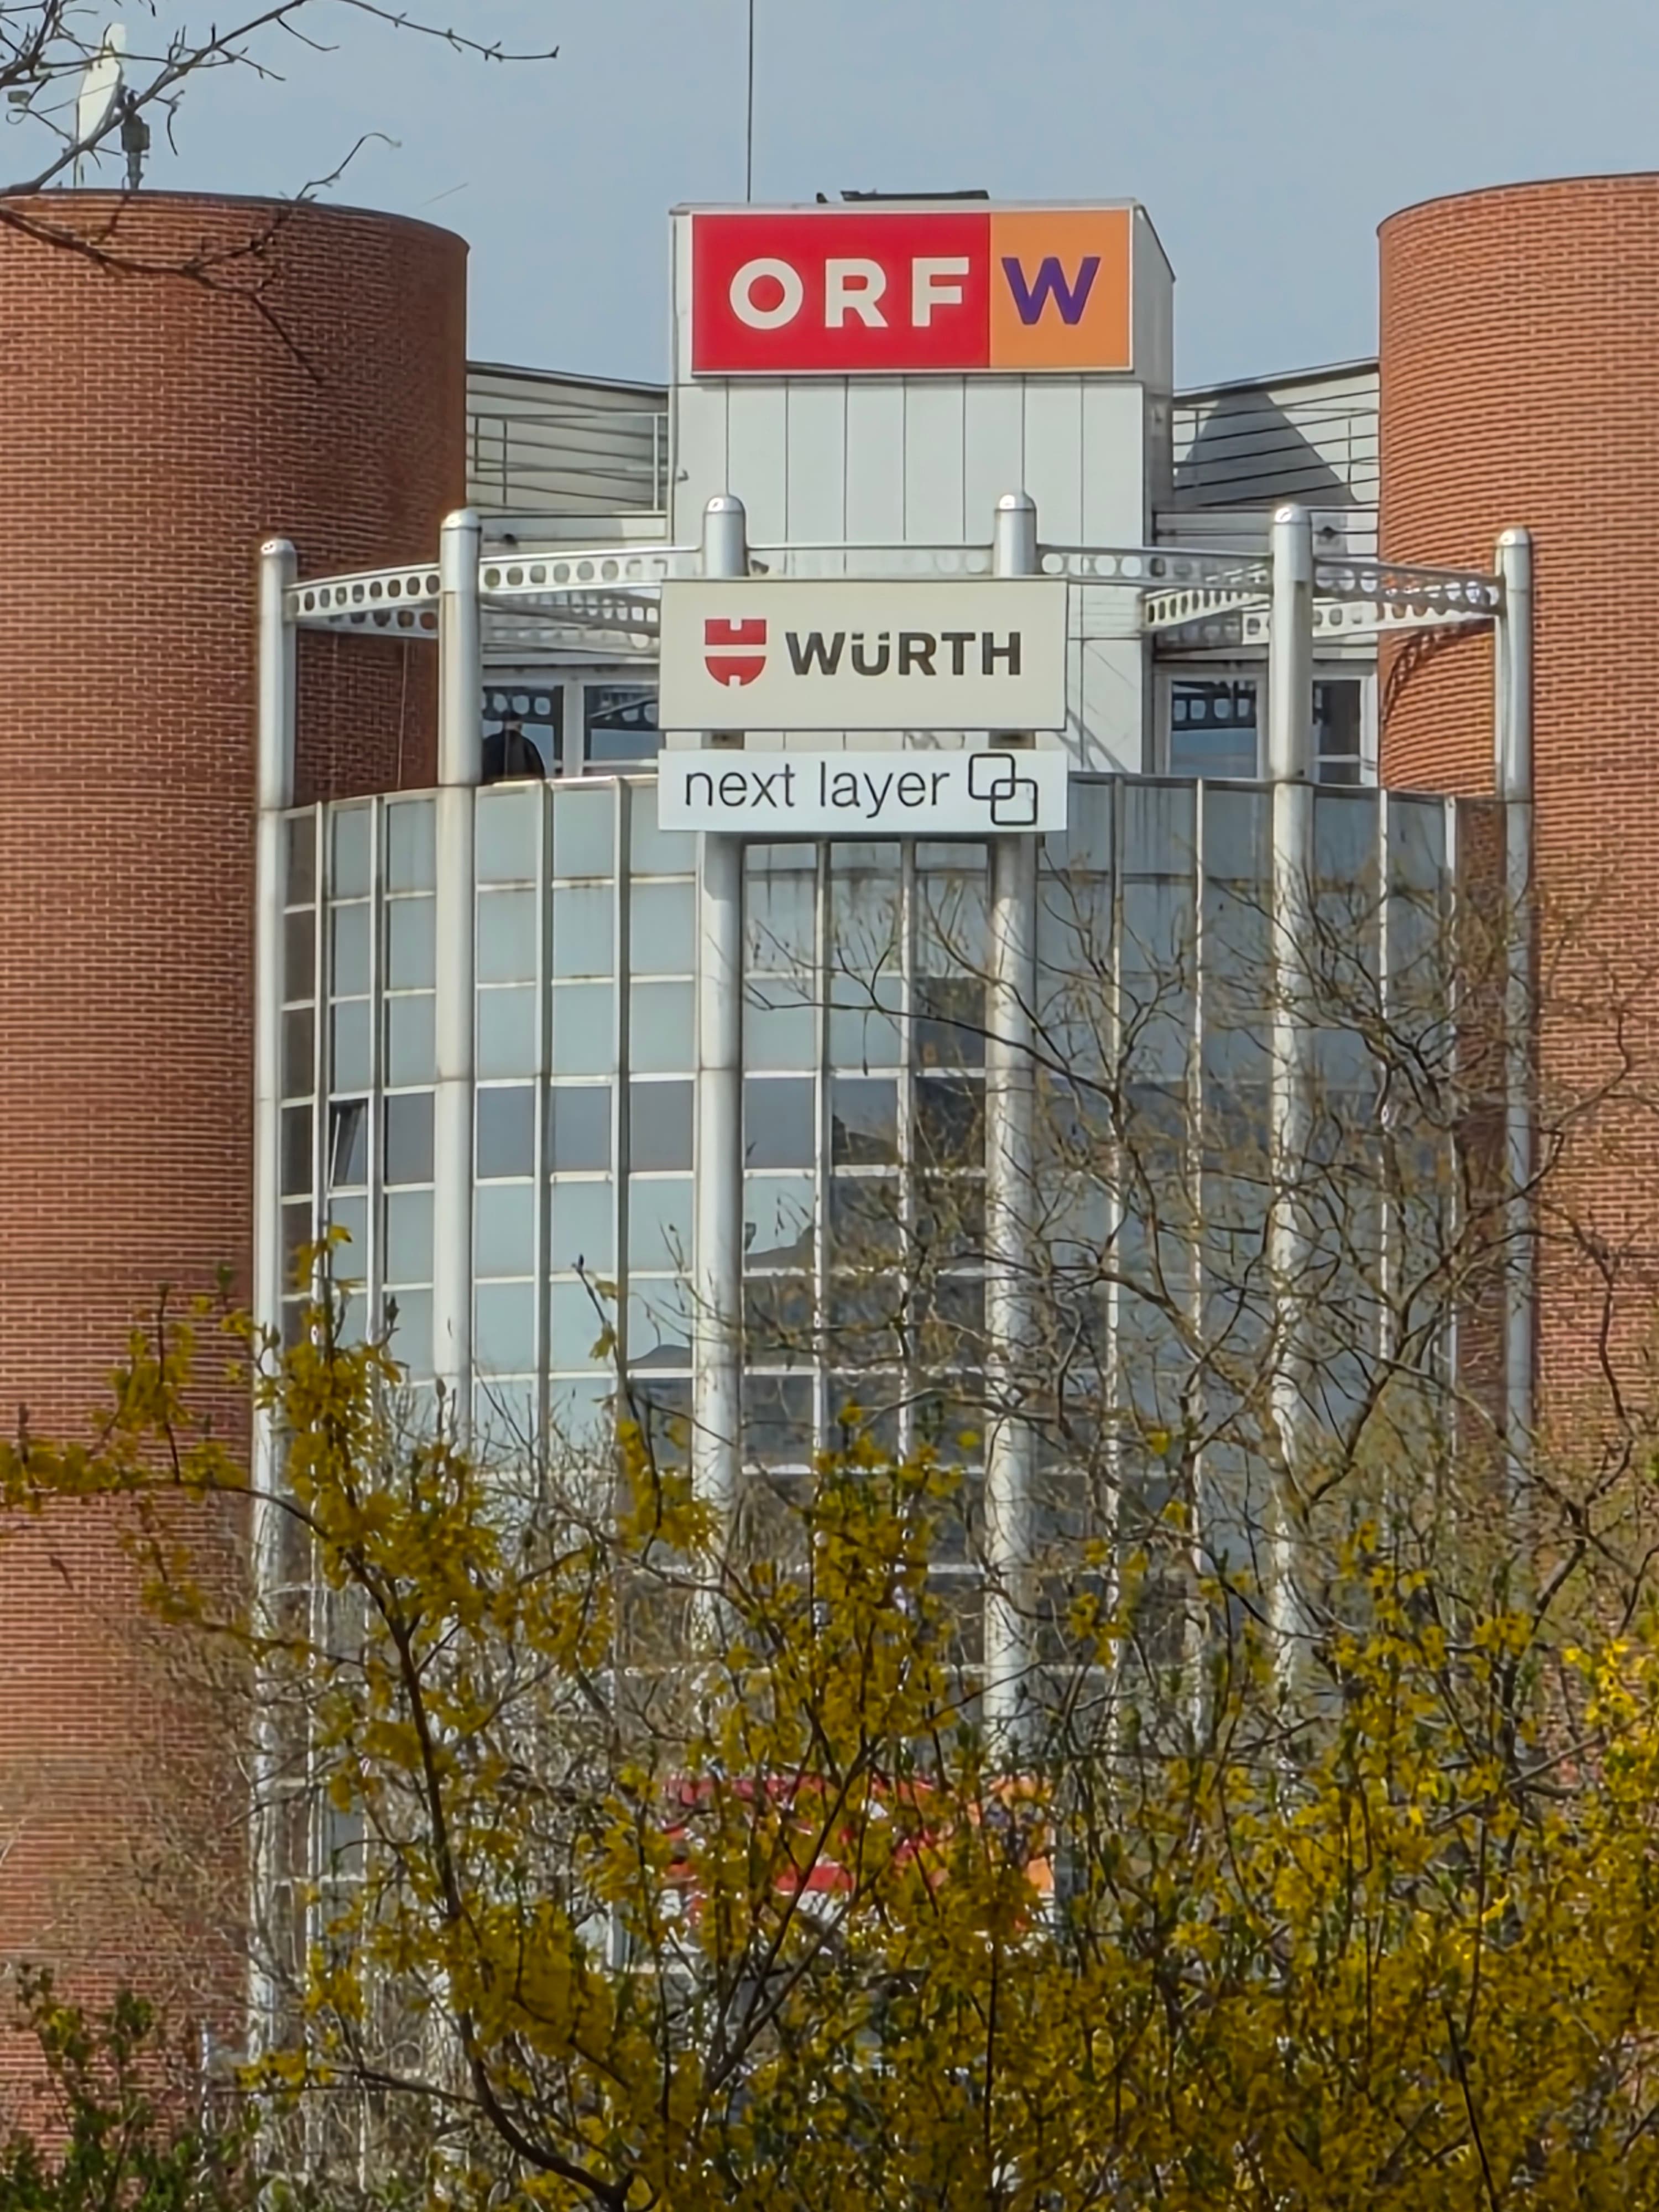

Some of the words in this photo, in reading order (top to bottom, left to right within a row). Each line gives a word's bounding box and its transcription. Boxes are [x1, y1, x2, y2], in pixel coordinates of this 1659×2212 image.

[784, 631, 1021, 676] WÜRTH
[685, 763, 796, 808] next
[820, 760, 951, 819] layer
